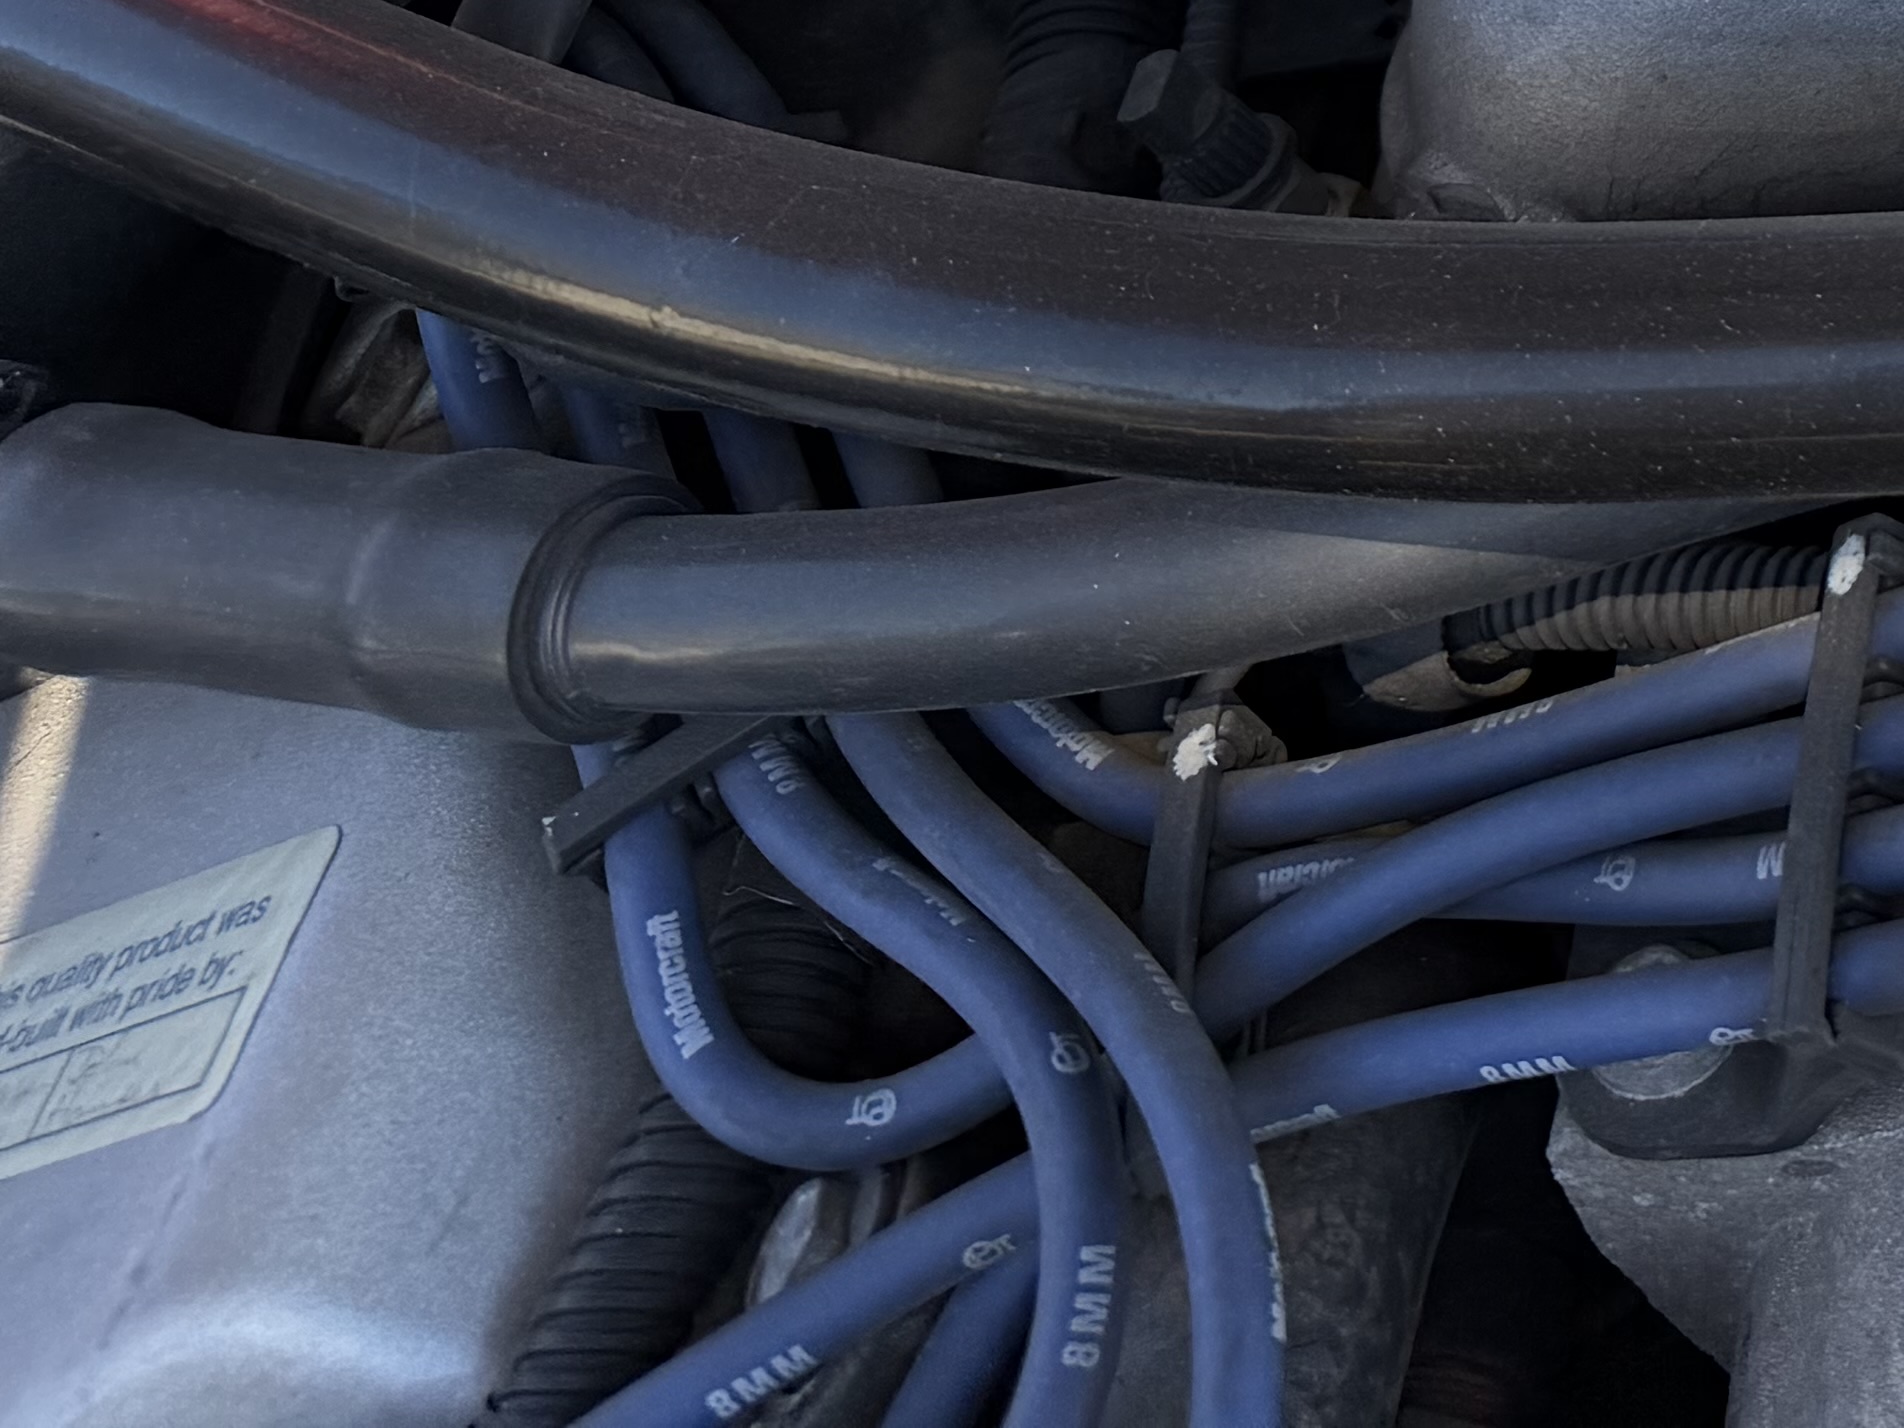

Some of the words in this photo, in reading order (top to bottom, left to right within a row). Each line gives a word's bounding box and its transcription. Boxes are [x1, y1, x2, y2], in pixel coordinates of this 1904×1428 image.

[28, 952, 115, 1004] quality
[104, 910, 218, 982] product
[215, 895, 272, 937] was
[69, 987, 125, 1032] with
[118, 963, 197, 1024] pride
[647, 910, 717, 1060] Motorcraft
[1060, 1244, 1117, 1370] 8MM
[705, 1343, 818, 1421] 8MM
